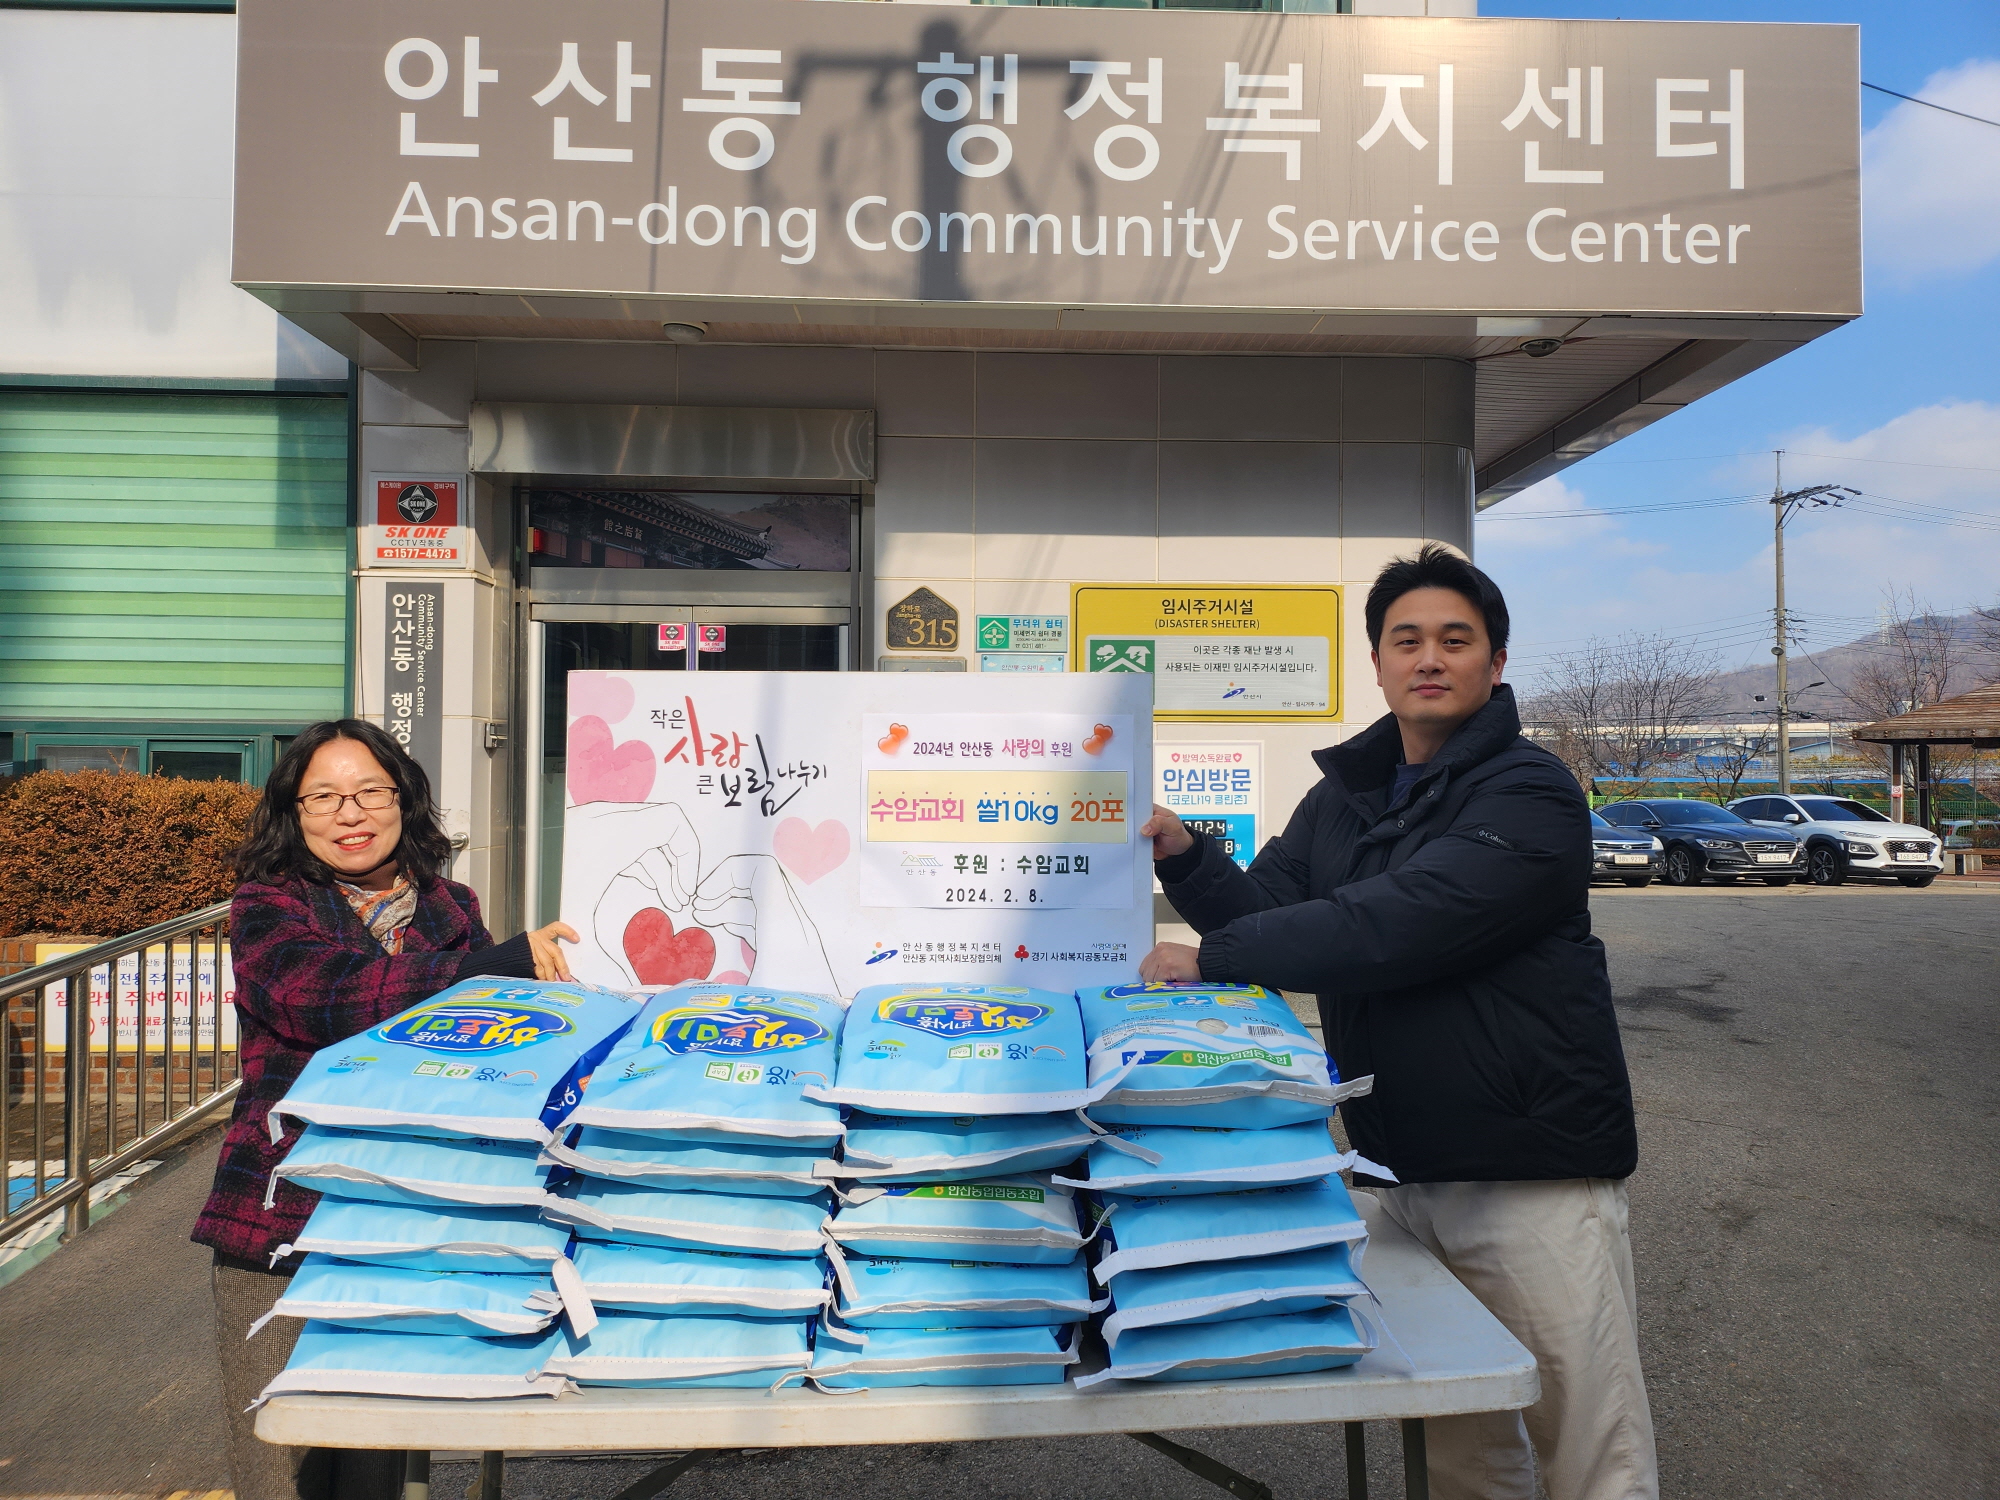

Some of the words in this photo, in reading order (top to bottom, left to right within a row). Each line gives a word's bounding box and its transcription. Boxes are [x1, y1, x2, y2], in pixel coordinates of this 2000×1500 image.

[384, 35, 801, 171] 안산동
[916, 51, 1745, 190] 행정복지센터
[385, 181, 817, 265] Ansan-dong
[845, 195, 1244, 275] Community
[1266, 204, 1500, 263] Service
[1526, 207, 1751, 265] Center
[385, 526, 411, 538] SK
[413, 527, 449, 539] ONE
[390, 539, 444, 548] CCTV작동중
[394, 548, 452, 559] 1577-4473
[1161, 599, 1253, 615] 임시주거시설
[416, 593, 427, 648] Community
[425, 593, 436, 651] Ansan-dong
[1013, 619, 1040, 628] 무더위
[1045, 619, 1063, 629] 쉼터
[1154, 618, 1209, 629] (DISASTER
[1211, 619, 1260, 630] SHELTER)
[391, 593, 416, 672] 안산동
[906, 618, 957, 646] 315
[1193, 645, 1220, 656] 이곳은
[1223, 645, 1241, 656] 각종
[1243, 645, 1262, 656] 재난
[1264, 645, 1282, 656] 발생
[1285, 646, 1294, 656] 시
[417, 650, 427, 684] Service
[1165, 662, 1201, 673] 사용되는
[1204, 662, 1231, 673] 이재민
[1233, 662, 1318, 673] 임시주거시설입니다.
[417, 685, 426, 718] Center
[649, 708, 686, 730] 작은
[664, 695, 749, 769] 사랑
[912, 741, 954, 758] 2024년
[960, 741, 994, 758] 안산동
[1001, 738, 1046, 759] 사랑의
[1050, 741, 1073, 758] 후원
[1182, 753, 1233, 763] 방역소독완료
[696, 775, 715, 796] 큰
[776, 760, 828, 788] 나누기
[1163, 768, 1252, 792] 안심방문
[870, 797, 965, 823] 수암교회
[976, 798, 1060, 826] 쌀10kg
[1070, 799, 1125, 823] 20포
[905, 868, 938, 877] 안산동
[953, 853, 988, 875] 후원
[1016, 854, 1090, 876] 수암교회
[945, 888, 994, 903] 2024.
[1003, 888, 1019, 903] 2.
[1028, 888, 1044, 903] 8.
[902, 953, 927, 964] 안산동
[929, 953, 1002, 964] 지역사회보장협의체
[1031, 951, 1048, 962] 경기
[1050, 951, 1127, 963] 사회복지공동모금회
[905, 1005, 1035, 1028] 햇토미
[405, 1015, 541, 1047] 햇토미
[678, 1018, 807, 1048] 햇토미
[1197, 1050, 1288, 1066] 안산농업협동조합
[711, 1069, 727, 1077] GAP
[948, 1185, 1041, 1201] 안산농업협동조합
